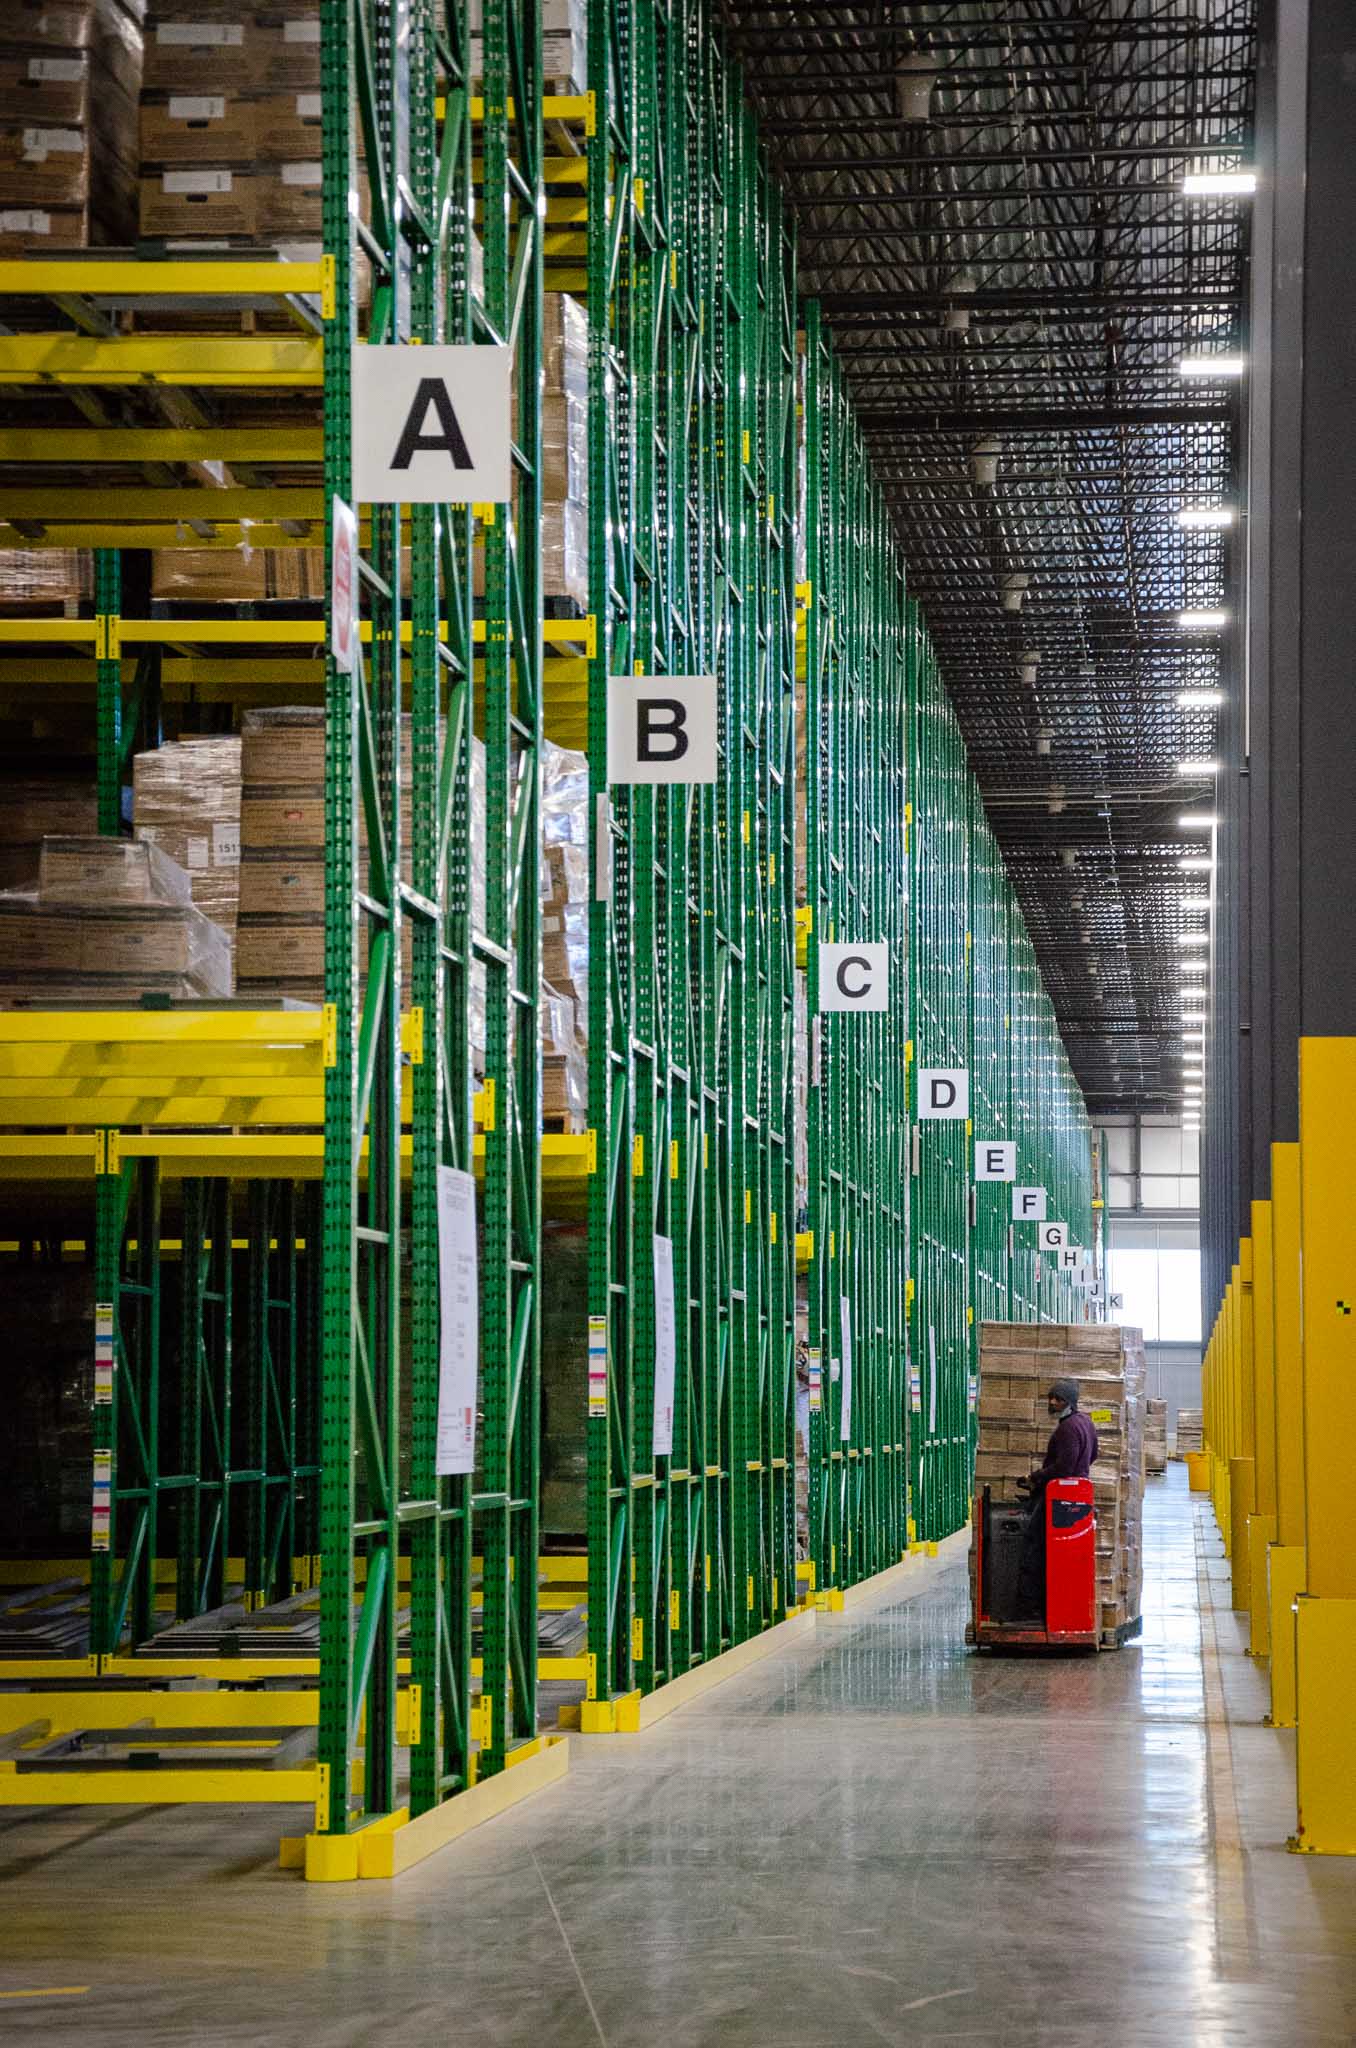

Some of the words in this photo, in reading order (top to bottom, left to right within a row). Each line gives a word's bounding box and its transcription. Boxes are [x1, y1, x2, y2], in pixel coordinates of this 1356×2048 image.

[390, 378, 474, 470] A
[637, 699, 688, 761] B
[836, 956, 872, 999] C
[931, 1080, 956, 1108] D
[986, 1149, 1005, 1173] E
[1022, 1194, 1037, 1214] F
[1046, 1228, 1061, 1246] G
[1064, 1251, 1076, 1266] H
[1081, 1269, 1085, 1283] I
[1090, 1283, 1098, 1296] J
[1110, 1295, 1119, 1307] K
